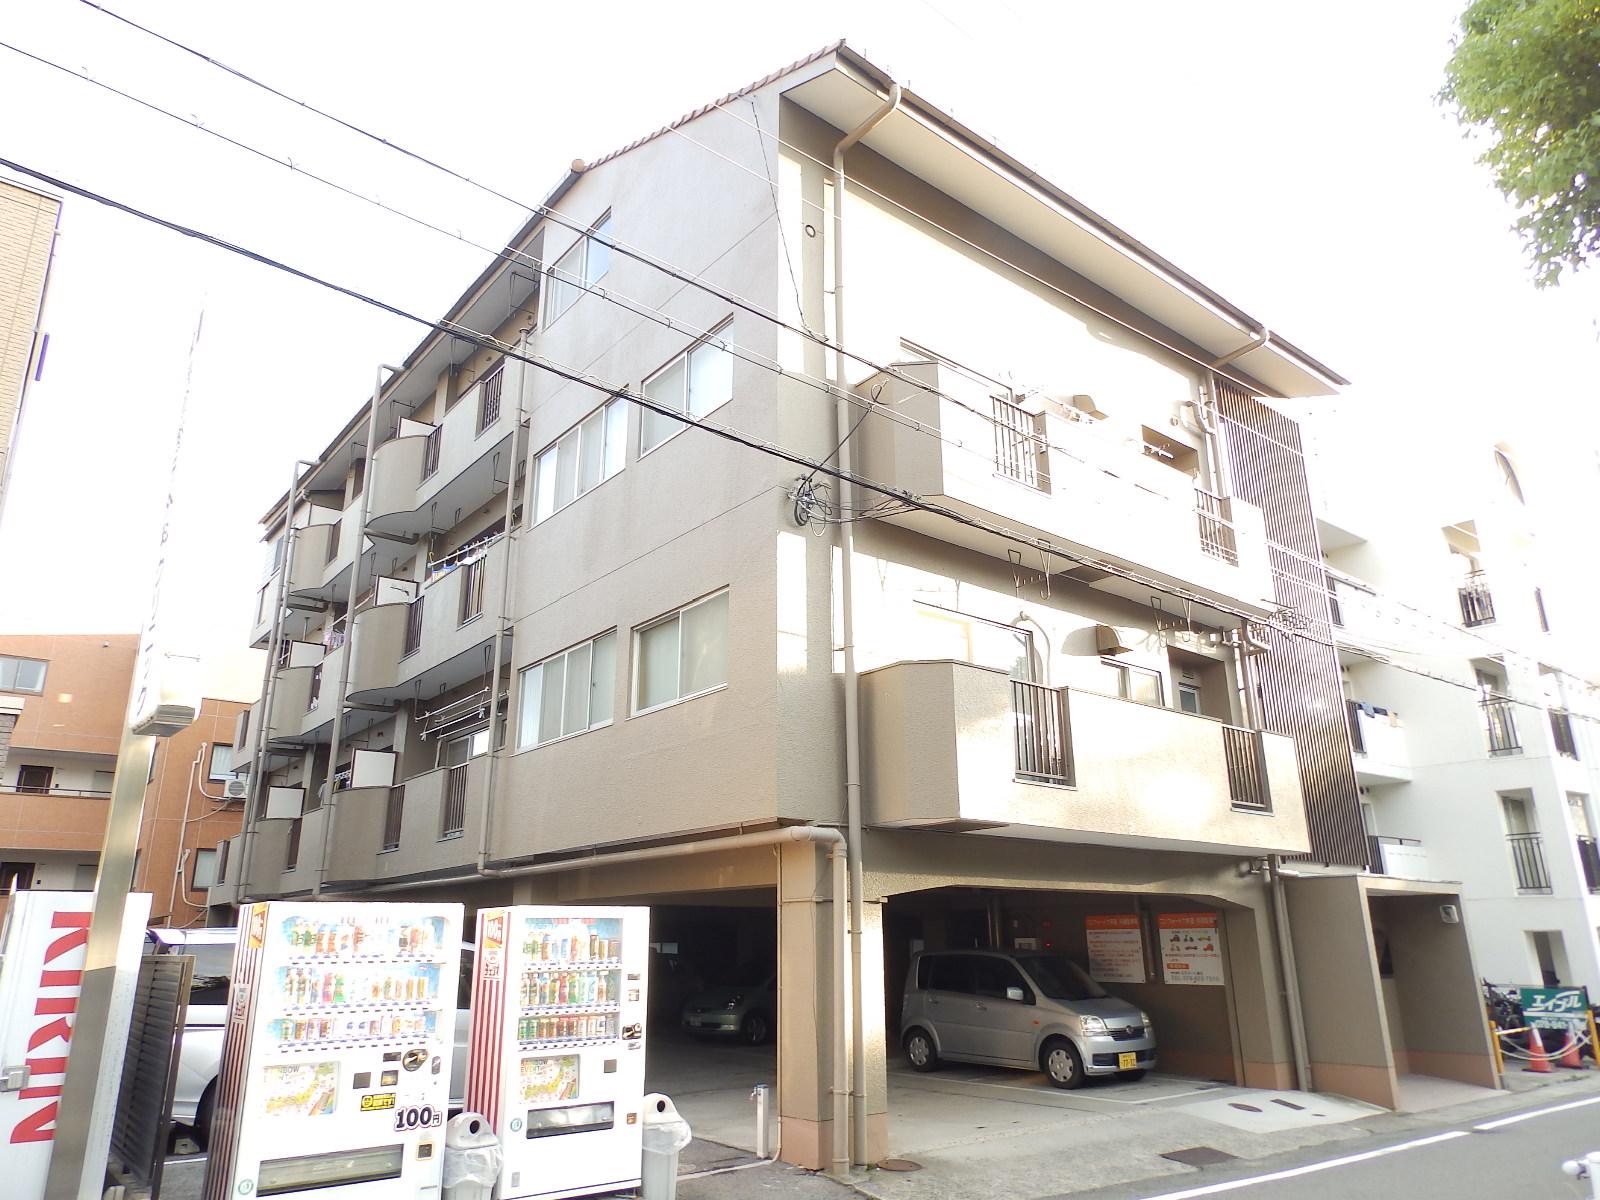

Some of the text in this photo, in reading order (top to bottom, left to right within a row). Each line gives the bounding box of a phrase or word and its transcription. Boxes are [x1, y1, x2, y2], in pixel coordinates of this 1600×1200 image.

[1527, 991, 1582, 1012] エイブル
[10, 911, 93, 1144] KIRIN
[396, 1107, 440, 1129] 100円
